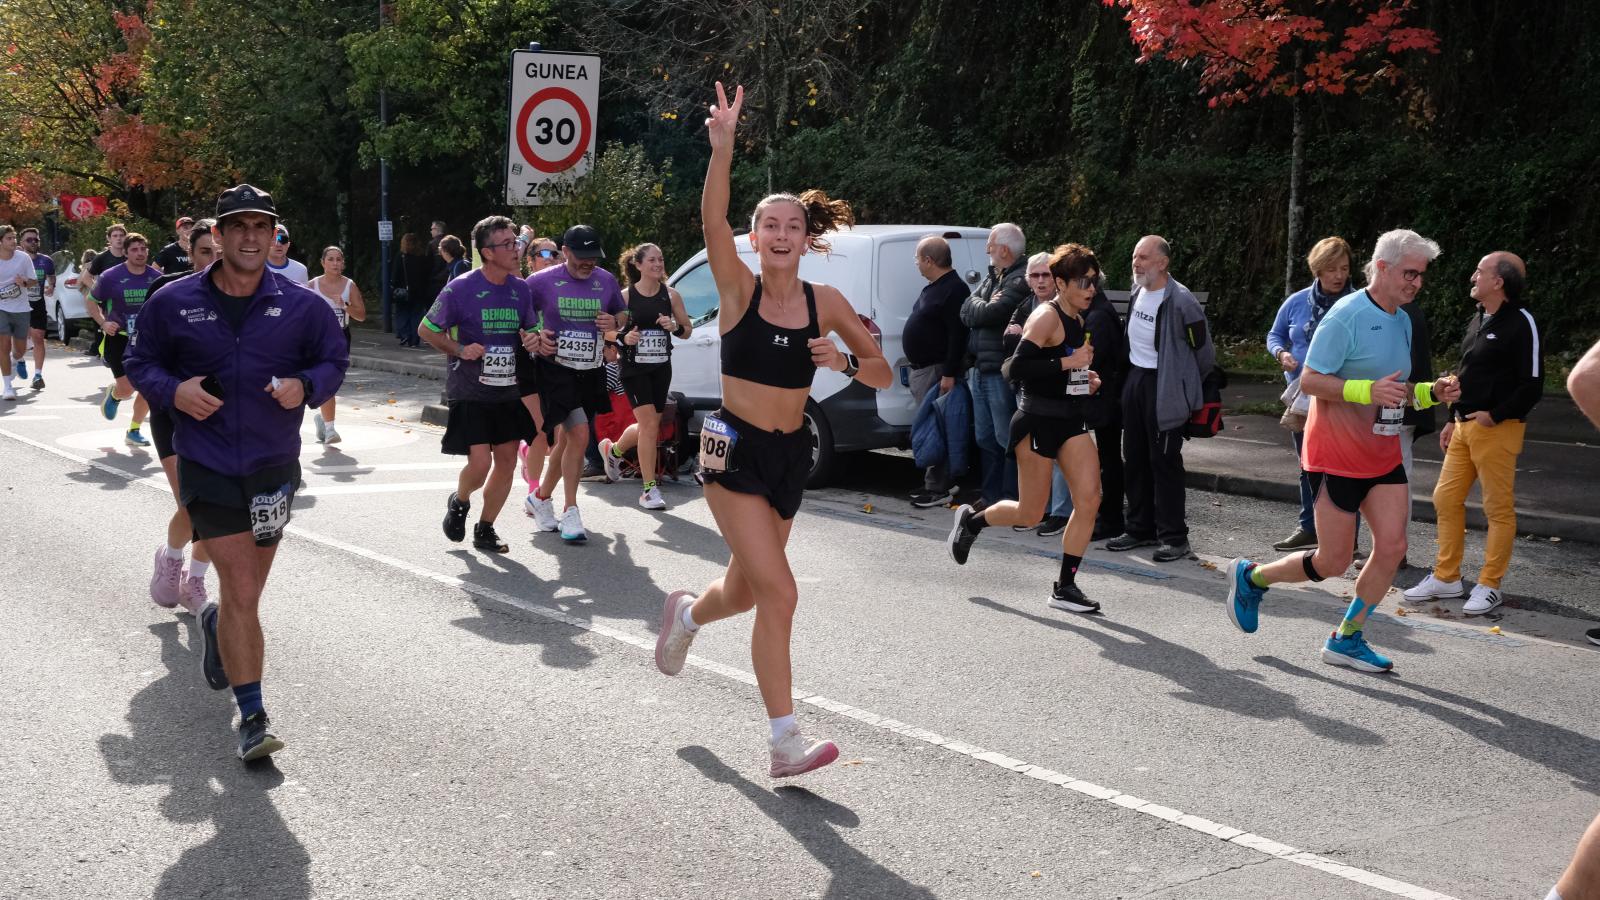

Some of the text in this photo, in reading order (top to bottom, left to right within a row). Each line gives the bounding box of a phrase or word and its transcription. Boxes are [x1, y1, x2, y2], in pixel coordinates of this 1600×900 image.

[525, 62, 588, 80] GUNEA
[534, 117, 576, 146] 30
[557, 297, 602, 310] BEHOBIA
[481, 308, 520, 321] BEHOBIA
[559, 339, 594, 352] 24355
[639, 338, 666, 348] 21150
